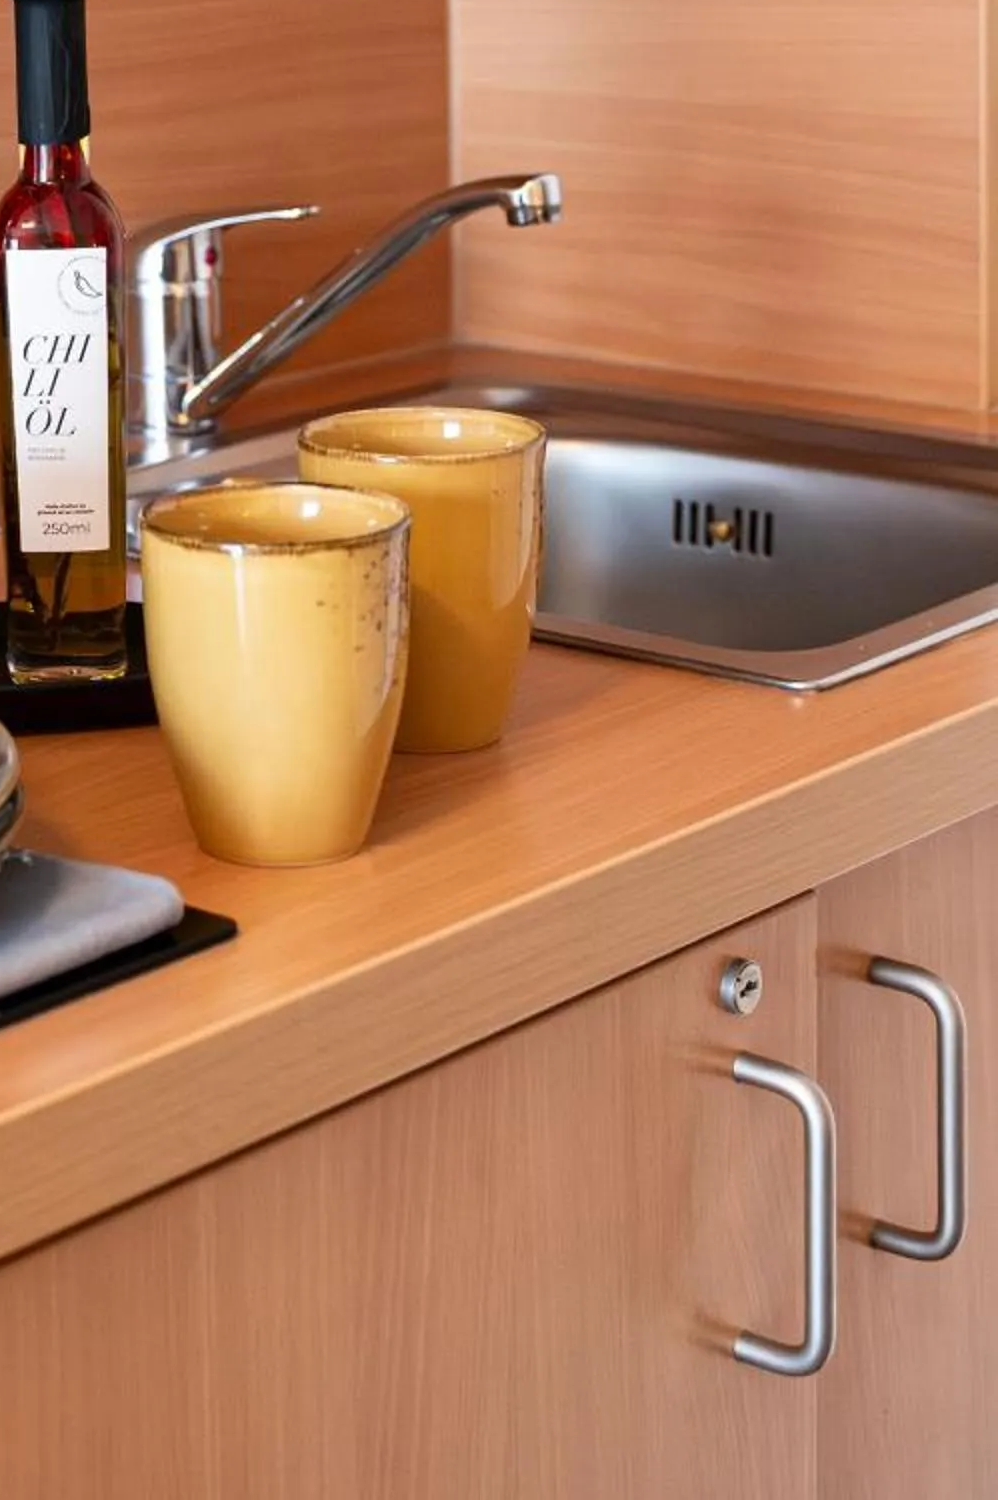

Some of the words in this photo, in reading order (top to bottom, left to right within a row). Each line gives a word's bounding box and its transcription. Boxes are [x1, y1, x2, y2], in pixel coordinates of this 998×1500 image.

[23, 333, 91, 364] CHI
[22, 367, 60, 397] LI
[25, 399, 77, 437] ÖL
[42, 521, 91, 535] 250ml
